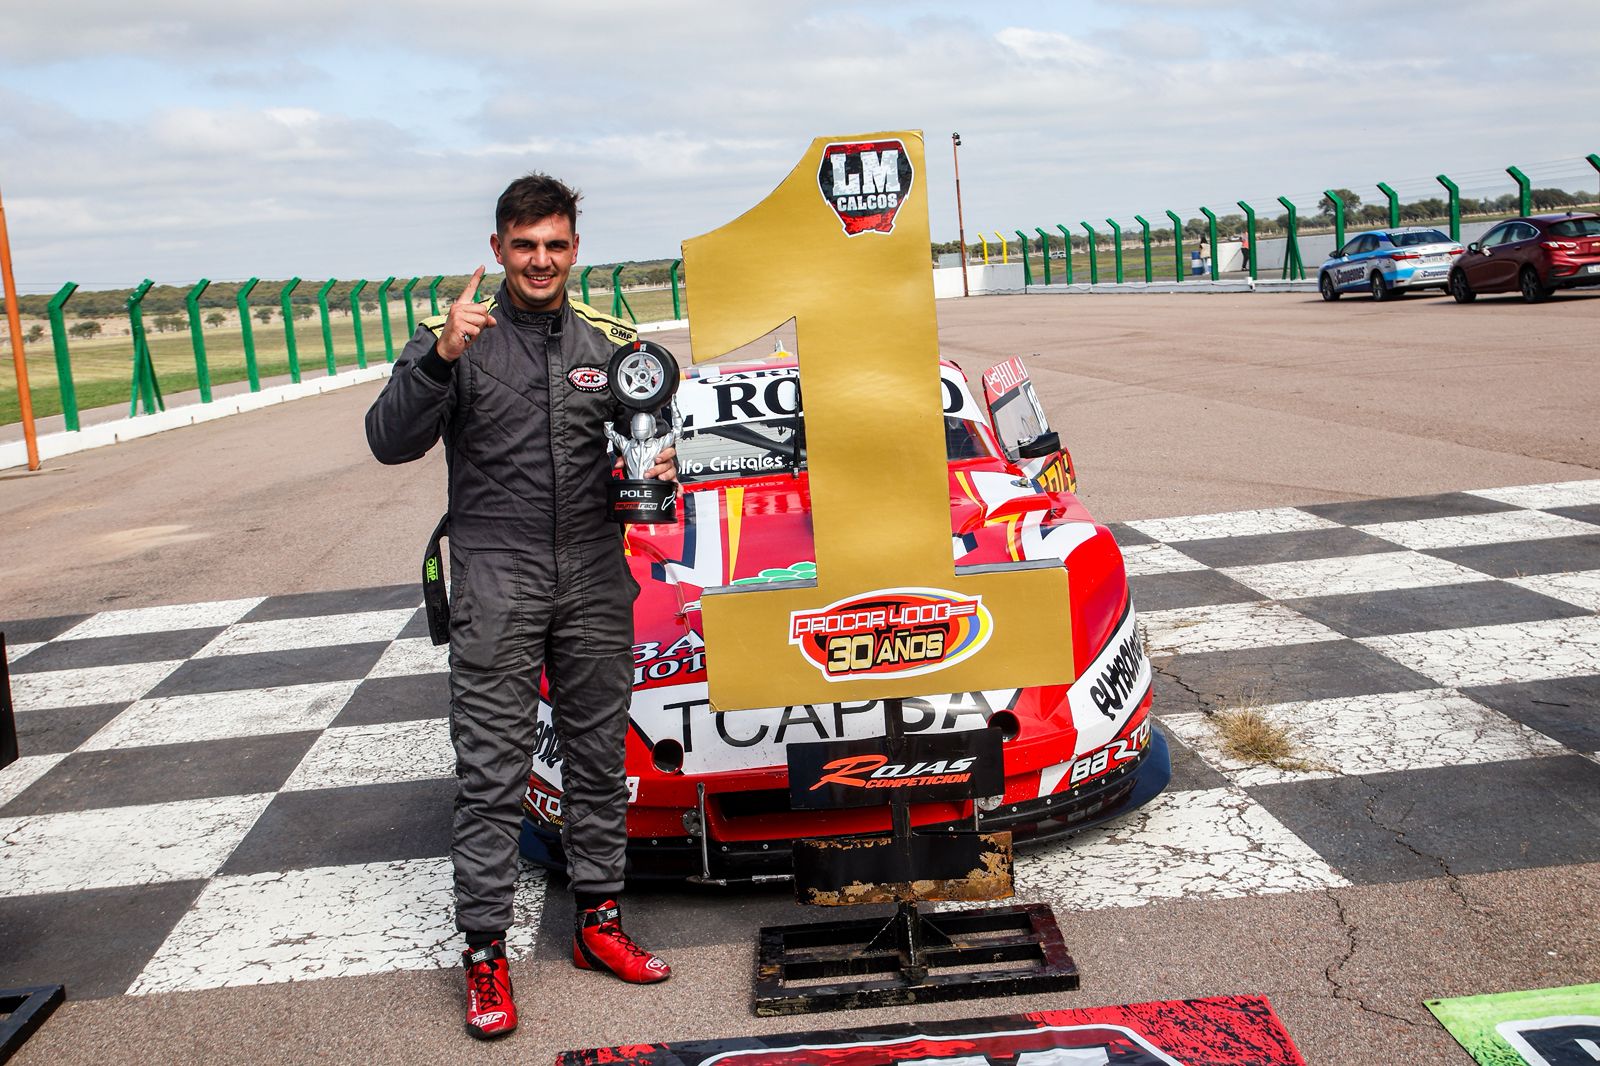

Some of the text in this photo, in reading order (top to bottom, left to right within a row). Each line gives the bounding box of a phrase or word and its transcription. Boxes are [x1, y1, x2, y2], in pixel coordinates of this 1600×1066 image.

[830, 149, 901, 196] LM
[837, 193, 898, 211] CALCOS
[610, 327, 633, 340] OMP
[578, 373, 600, 384] ACTC
[709, 453, 784, 472] Cristales
[620, 489, 653, 498] POLE
[426, 557, 438, 583] OMP
[795, 602, 951, 635] PROCAR 4000
[631, 629, 705, 664] BA
[827, 632, 944, 672] 30 AÑOS
[865, 772, 972, 789] COMPETICION
